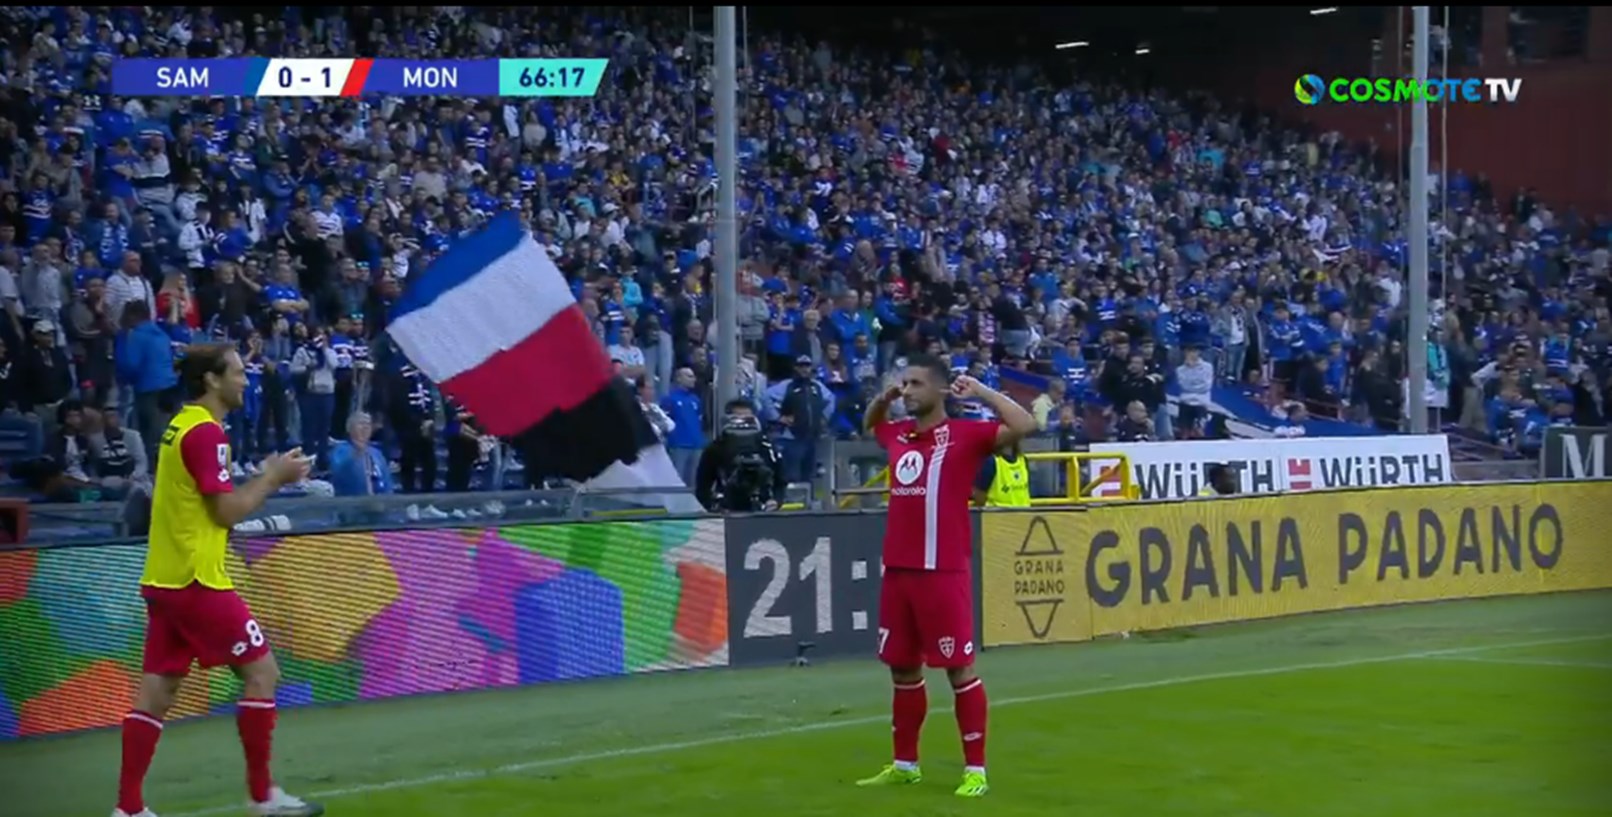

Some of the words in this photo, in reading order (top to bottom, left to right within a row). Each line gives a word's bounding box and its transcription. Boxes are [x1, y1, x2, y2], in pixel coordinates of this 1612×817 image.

[1135, 459, 1274, 499] WÜTH
[1014, 560, 1064, 575] GRANA
[1086, 516, 1308, 607] GRANA
[1338, 503, 1564, 585] PADANO
[1014, 580, 1065, 595] PADANO
